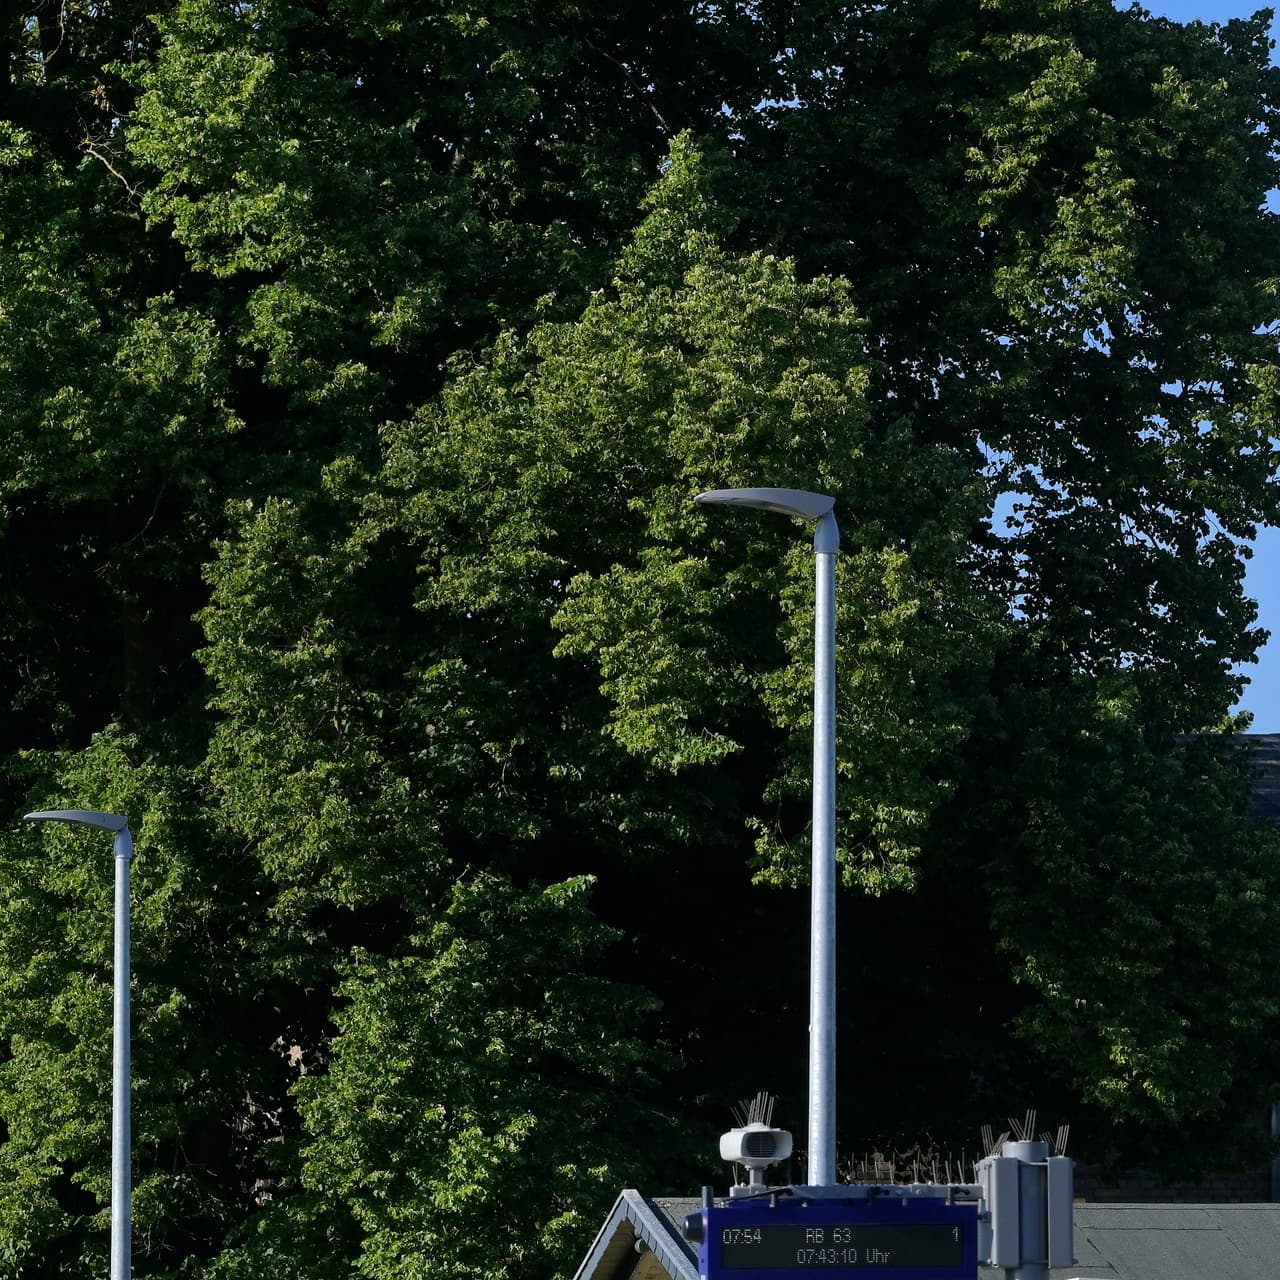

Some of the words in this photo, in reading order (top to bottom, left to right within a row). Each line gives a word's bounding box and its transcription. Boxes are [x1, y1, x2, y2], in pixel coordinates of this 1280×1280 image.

[723, 1229, 762, 1244] 07:54
[806, 1228, 824, 1244] RB
[833, 1227, 851, 1243] 63
[952, 1226, 960, 1243] 1
[797, 1249, 857, 1264] 07:43:10
[866, 1248, 891, 1263] Uhr
